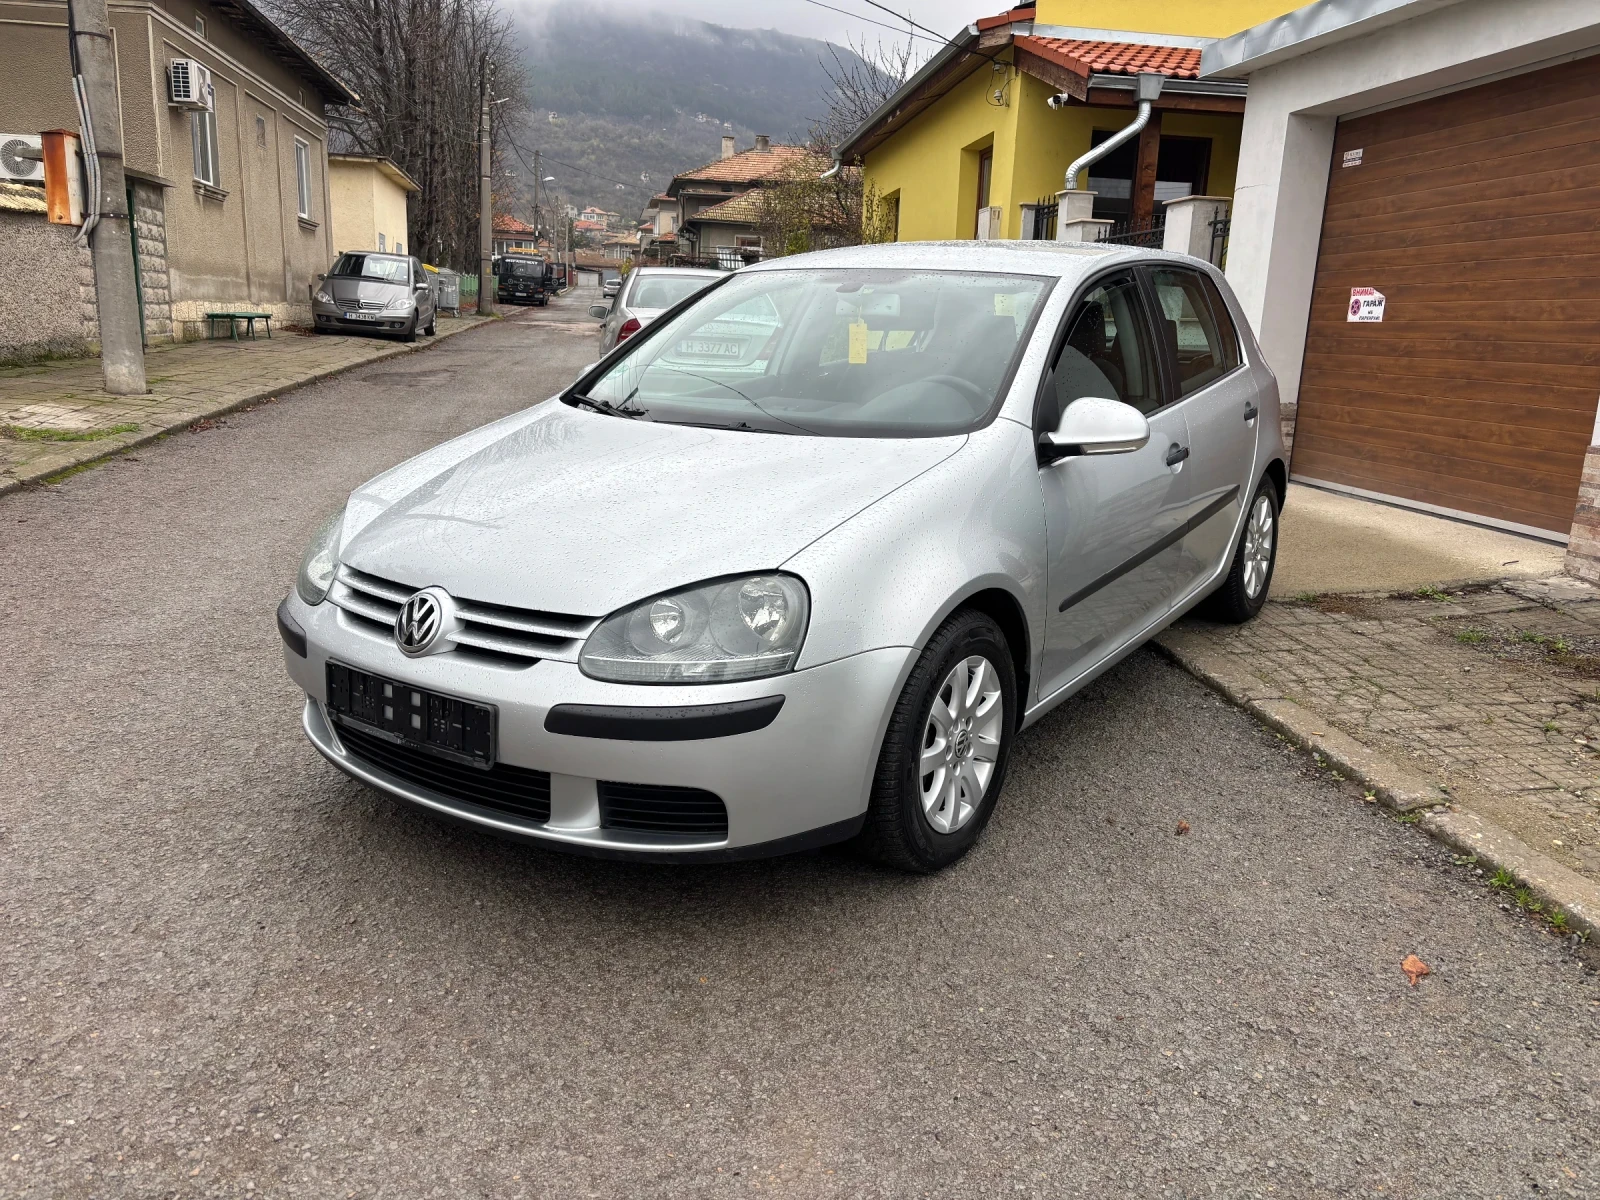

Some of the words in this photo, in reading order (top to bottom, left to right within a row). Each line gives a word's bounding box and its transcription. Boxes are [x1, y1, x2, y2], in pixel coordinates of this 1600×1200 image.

[686, 341, 693, 352] H
[698, 342, 722, 353] 3377
[724, 344, 737, 354] AC
